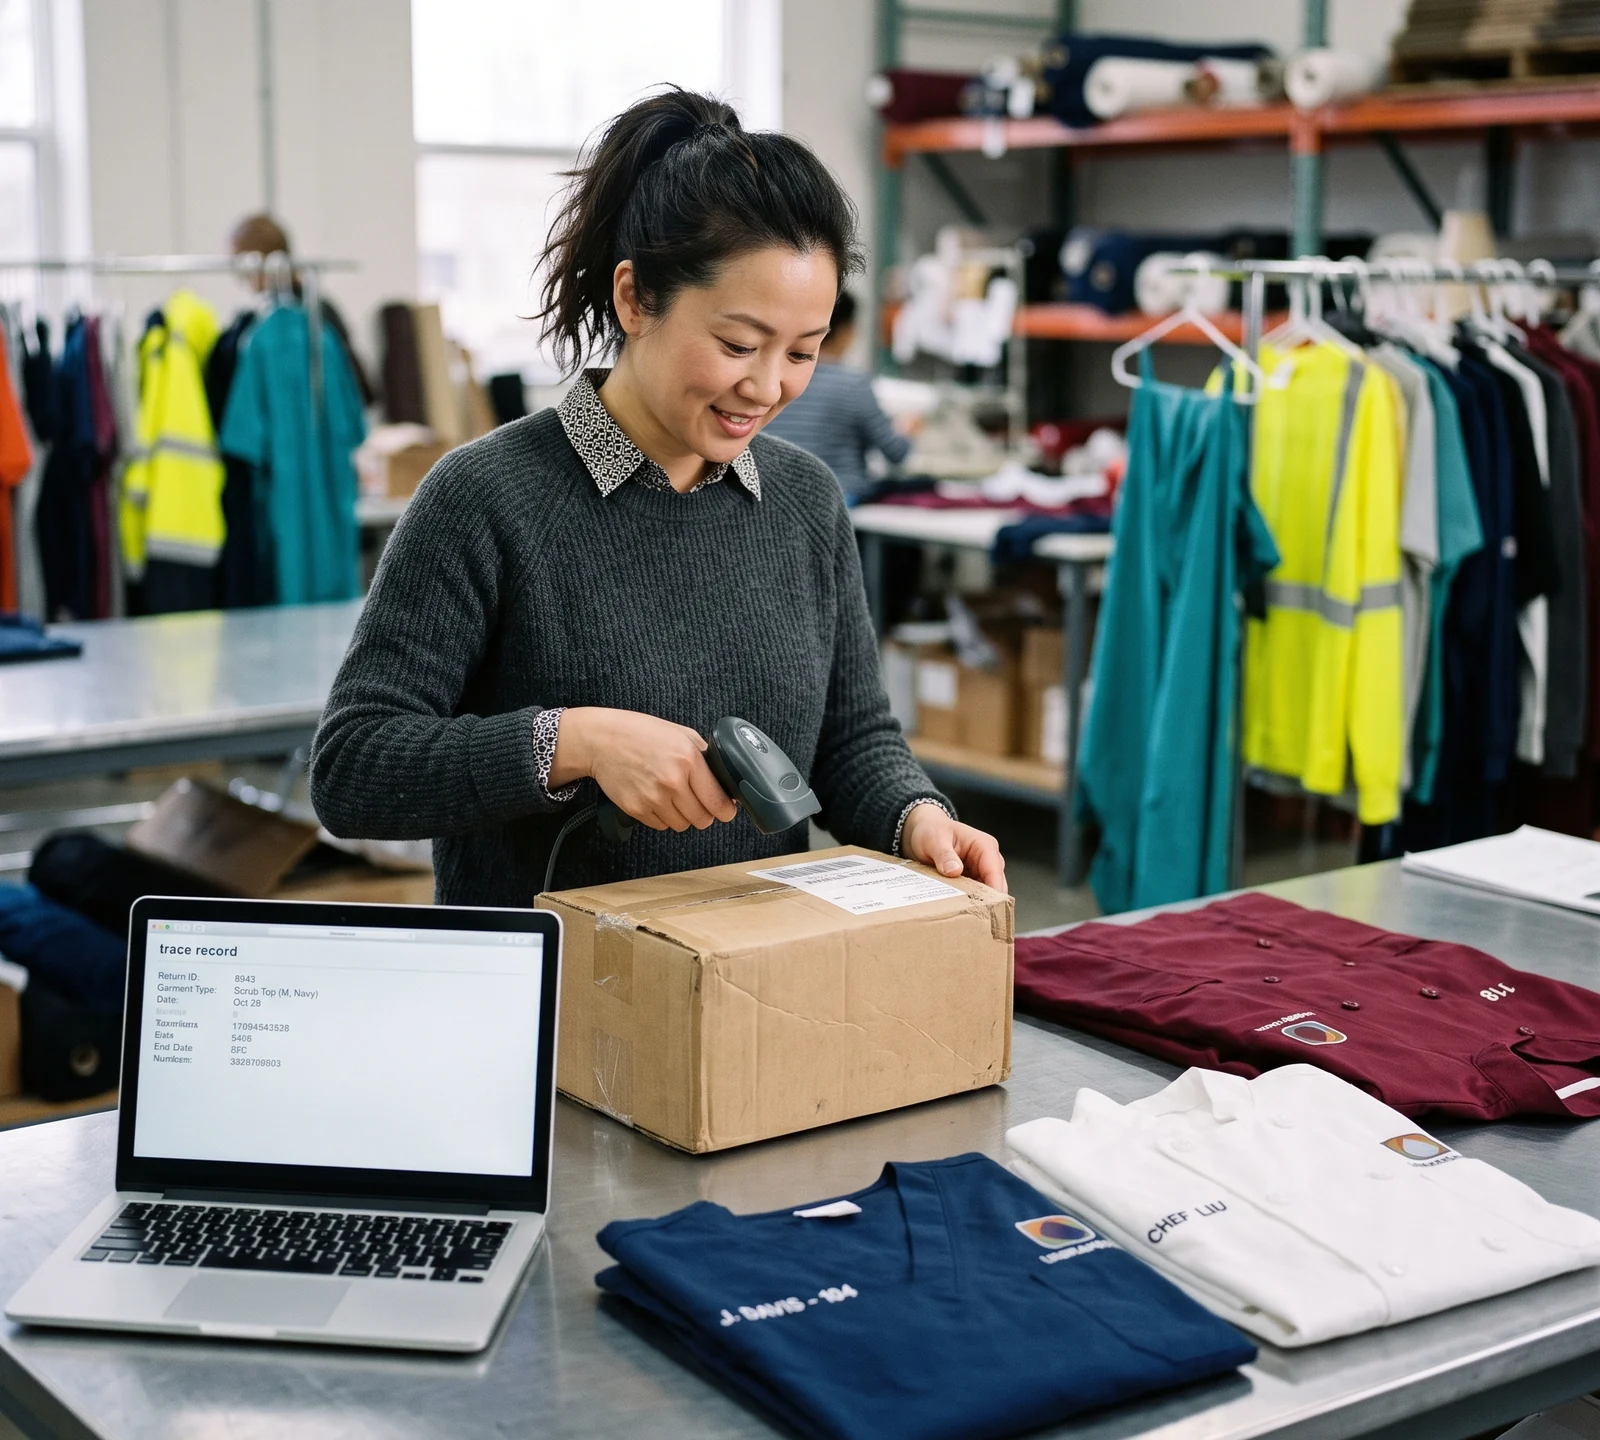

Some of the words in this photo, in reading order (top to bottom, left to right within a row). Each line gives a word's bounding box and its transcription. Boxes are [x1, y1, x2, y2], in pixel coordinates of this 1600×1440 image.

[159, 944, 192, 955] trace
[195, 946, 238, 957] record
[158, 972, 186, 981] Return
[188, 973, 200, 981] ID:
[234, 975, 256, 983] 8943
[157, 984, 194, 993] Garment
[195, 985, 217, 995] Type:
[234, 986, 259, 996] Scrub
[261, 988, 276, 998] Top
[278, 988, 292, 998] (M,
[294, 989, 319, 1000] Navy)
[1479, 982, 1516, 1002] 118
[156, 996, 179, 1004] Date:
[233, 998, 249, 1007] Oct
[250, 999, 262, 1007] 28
[154, 1042, 171, 1051] End
[173, 1043, 193, 1052] Date
[1147, 1210, 1188, 1244] CHEF
[1194, 1200, 1227, 1217] LIU
[737, 1296, 806, 1321] DAVIS
